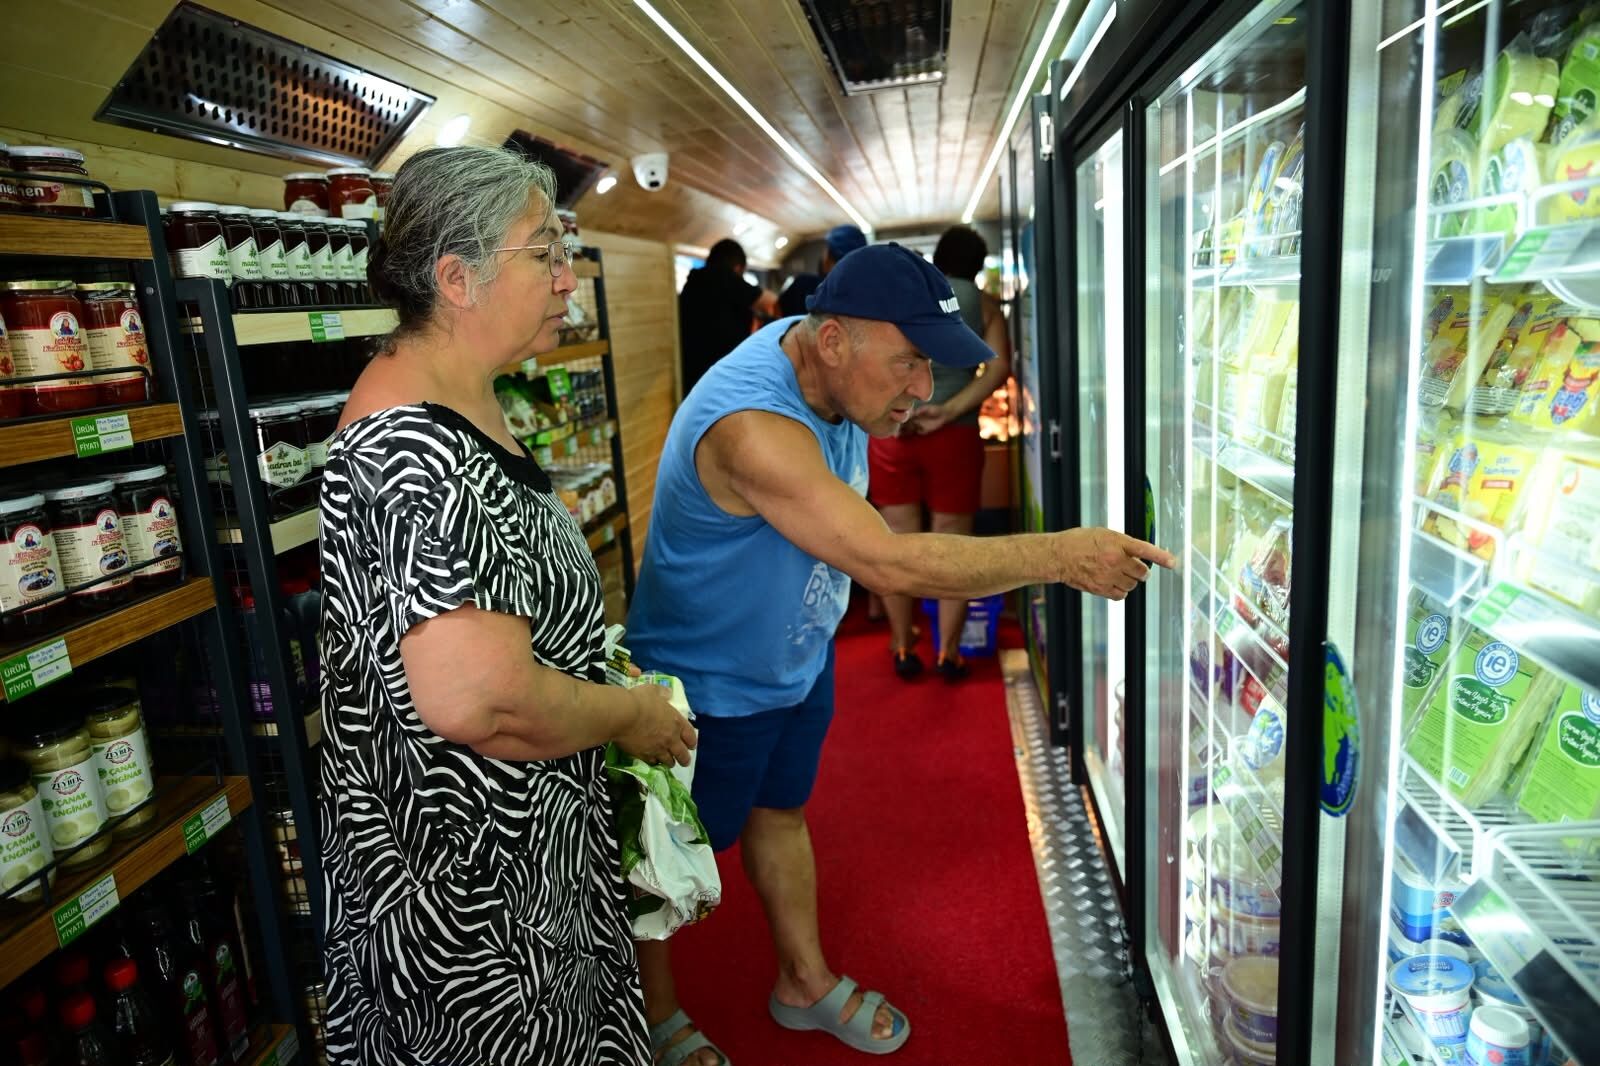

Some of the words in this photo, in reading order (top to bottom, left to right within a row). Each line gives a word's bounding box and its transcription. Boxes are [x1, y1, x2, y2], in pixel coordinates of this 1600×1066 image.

[75, 423, 96, 434] ÜRÜN
[79, 440, 100, 453] FİYATI
[4, 661, 27, 678] ÜRÜN
[9, 679, 33, 696] FİYATI
[105, 745, 135, 760] ZEYBEK
[106, 768, 143, 786] ENGİNAR
[108, 761, 137, 776] ÇANAK
[51, 776, 84, 791] ZEYBEK
[55, 792, 88, 808] ÇANAK
[52, 800, 94, 818] ENGİNAR
[1, 815, 32, 833] ZEYBEK
[5, 831, 36, 851] ÇANAK
[2, 840, 41, 863] ENGİNAR
[57, 905, 79, 924] ÜRÜN
[62, 921, 83, 940] FİYATI
